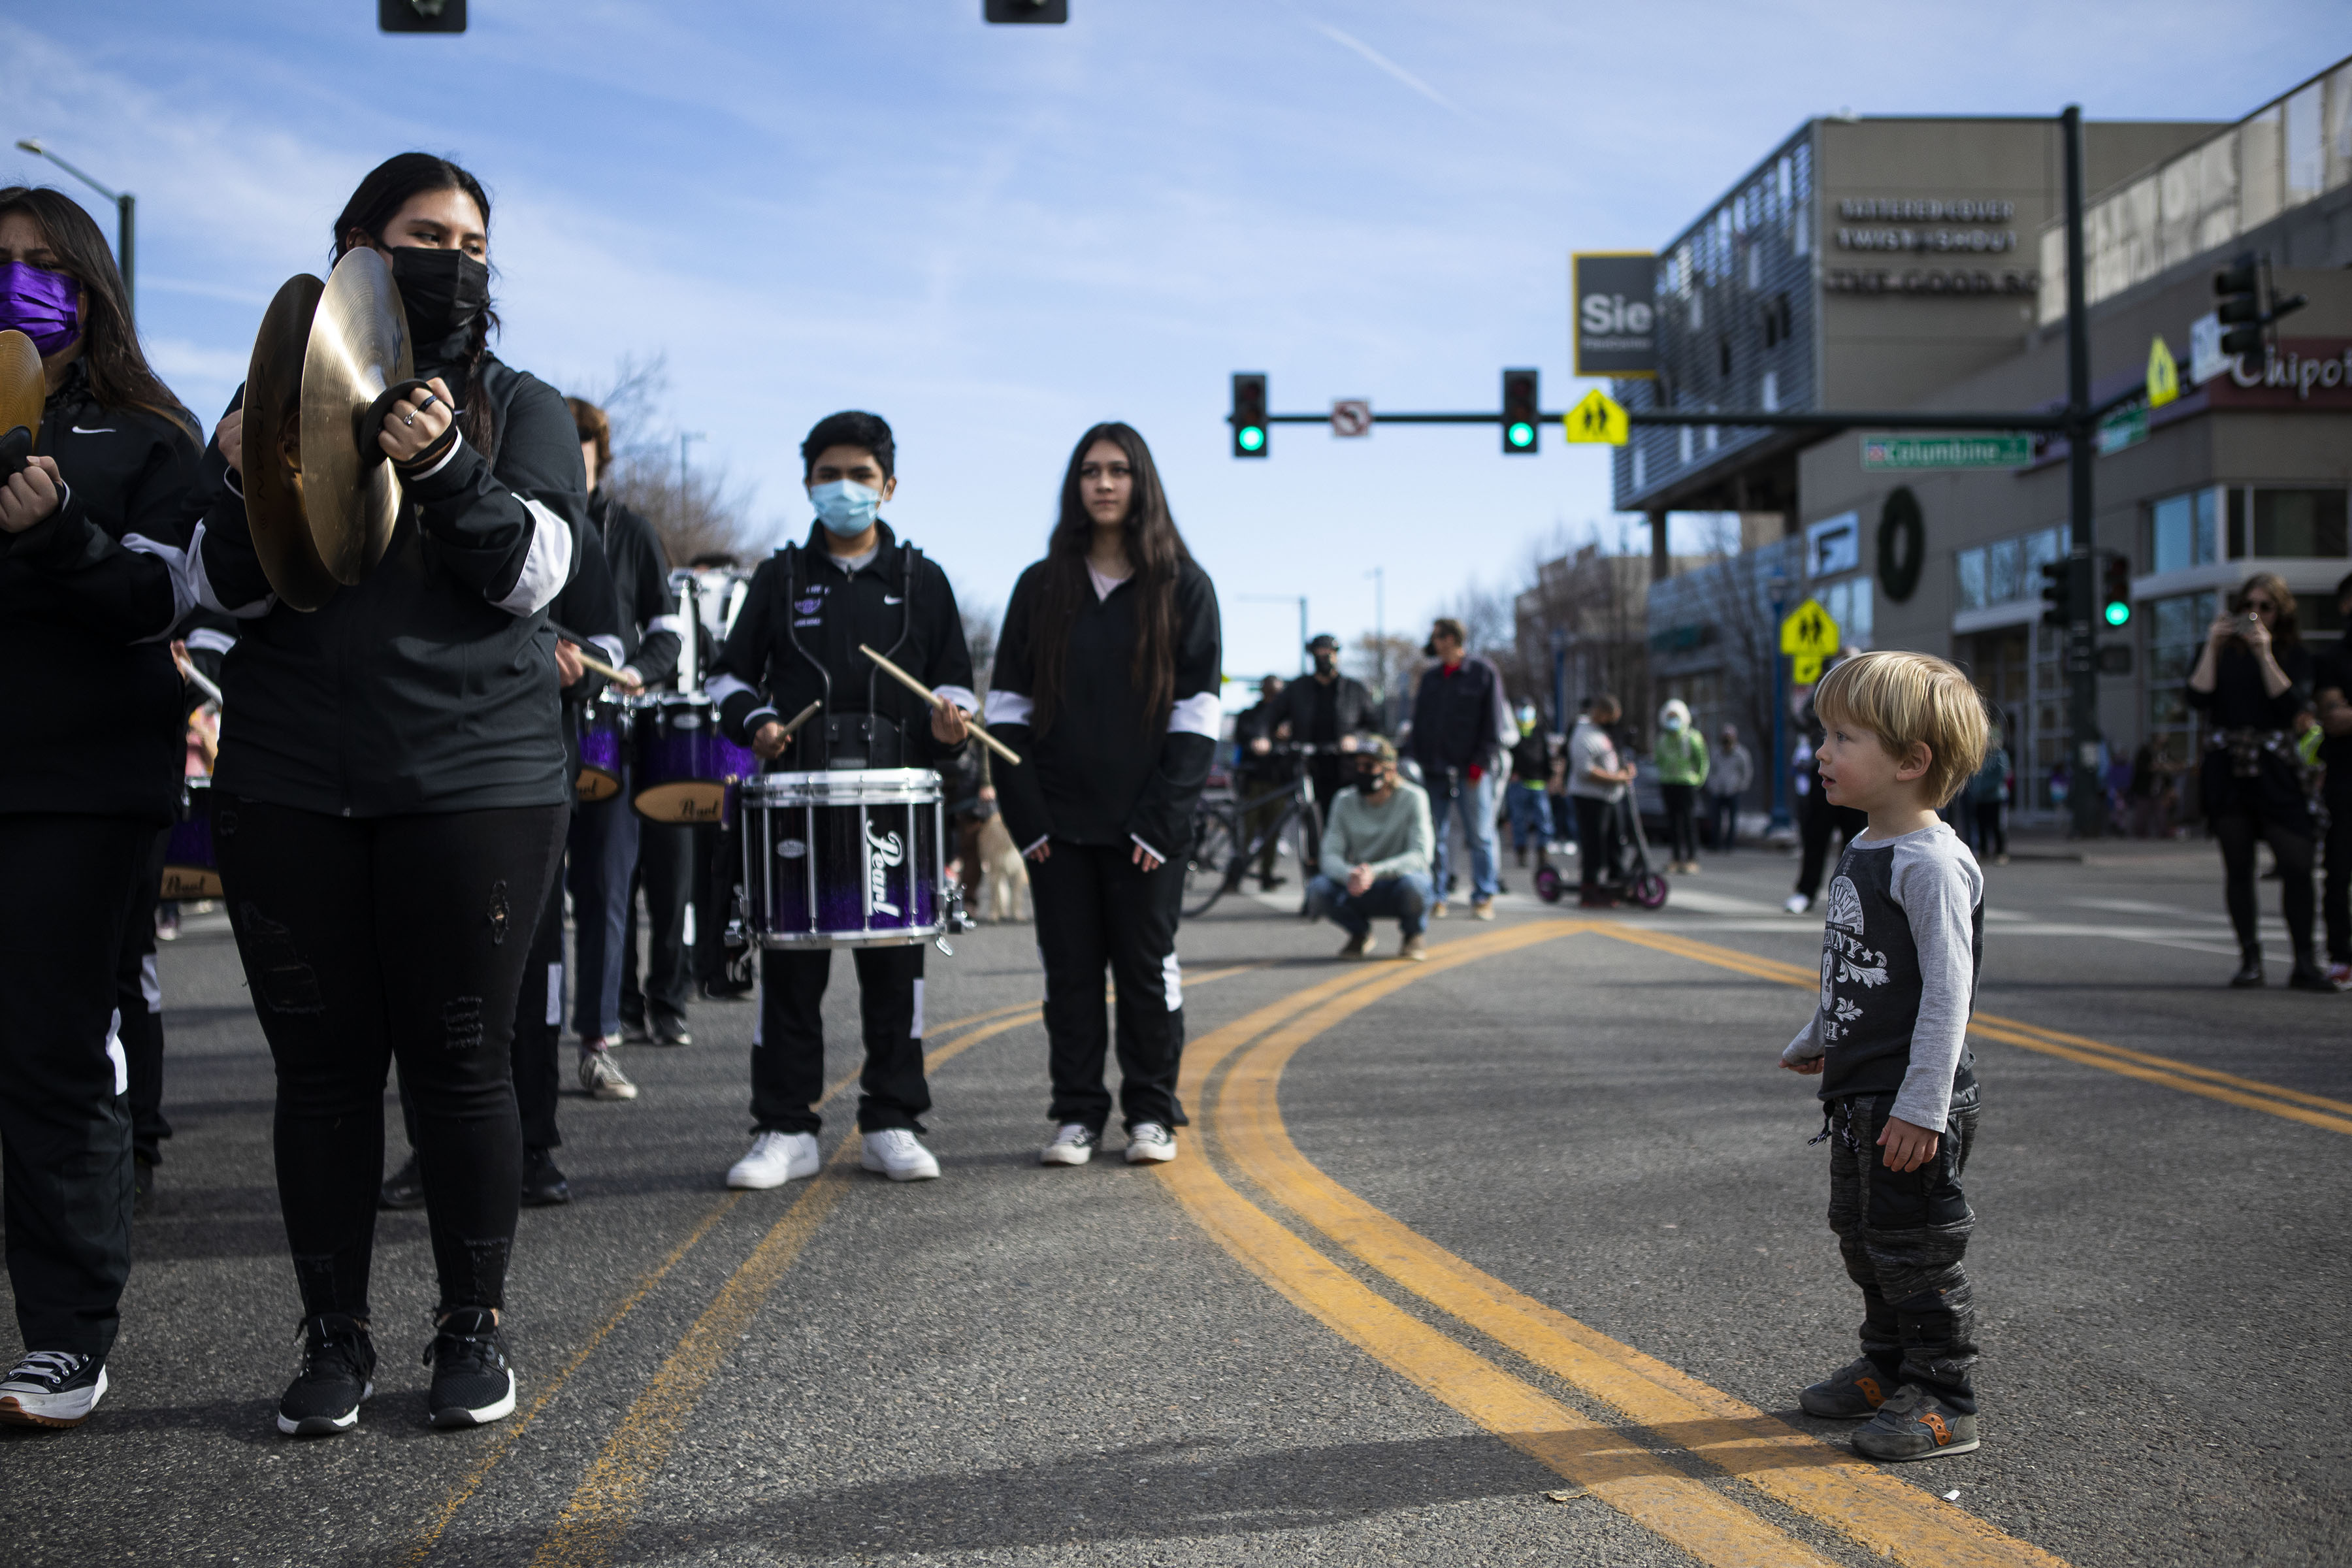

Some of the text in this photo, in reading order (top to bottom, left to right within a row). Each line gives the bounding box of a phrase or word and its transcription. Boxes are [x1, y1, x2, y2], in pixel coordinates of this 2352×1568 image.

[1581, 293, 1654, 335] Sie
[1886, 436, 2000, 463] Columbine
[865, 819, 906, 918] Pearl
[1823, 928, 1864, 959] HNNY
[1834, 924, 1853, 932] COMPANY
